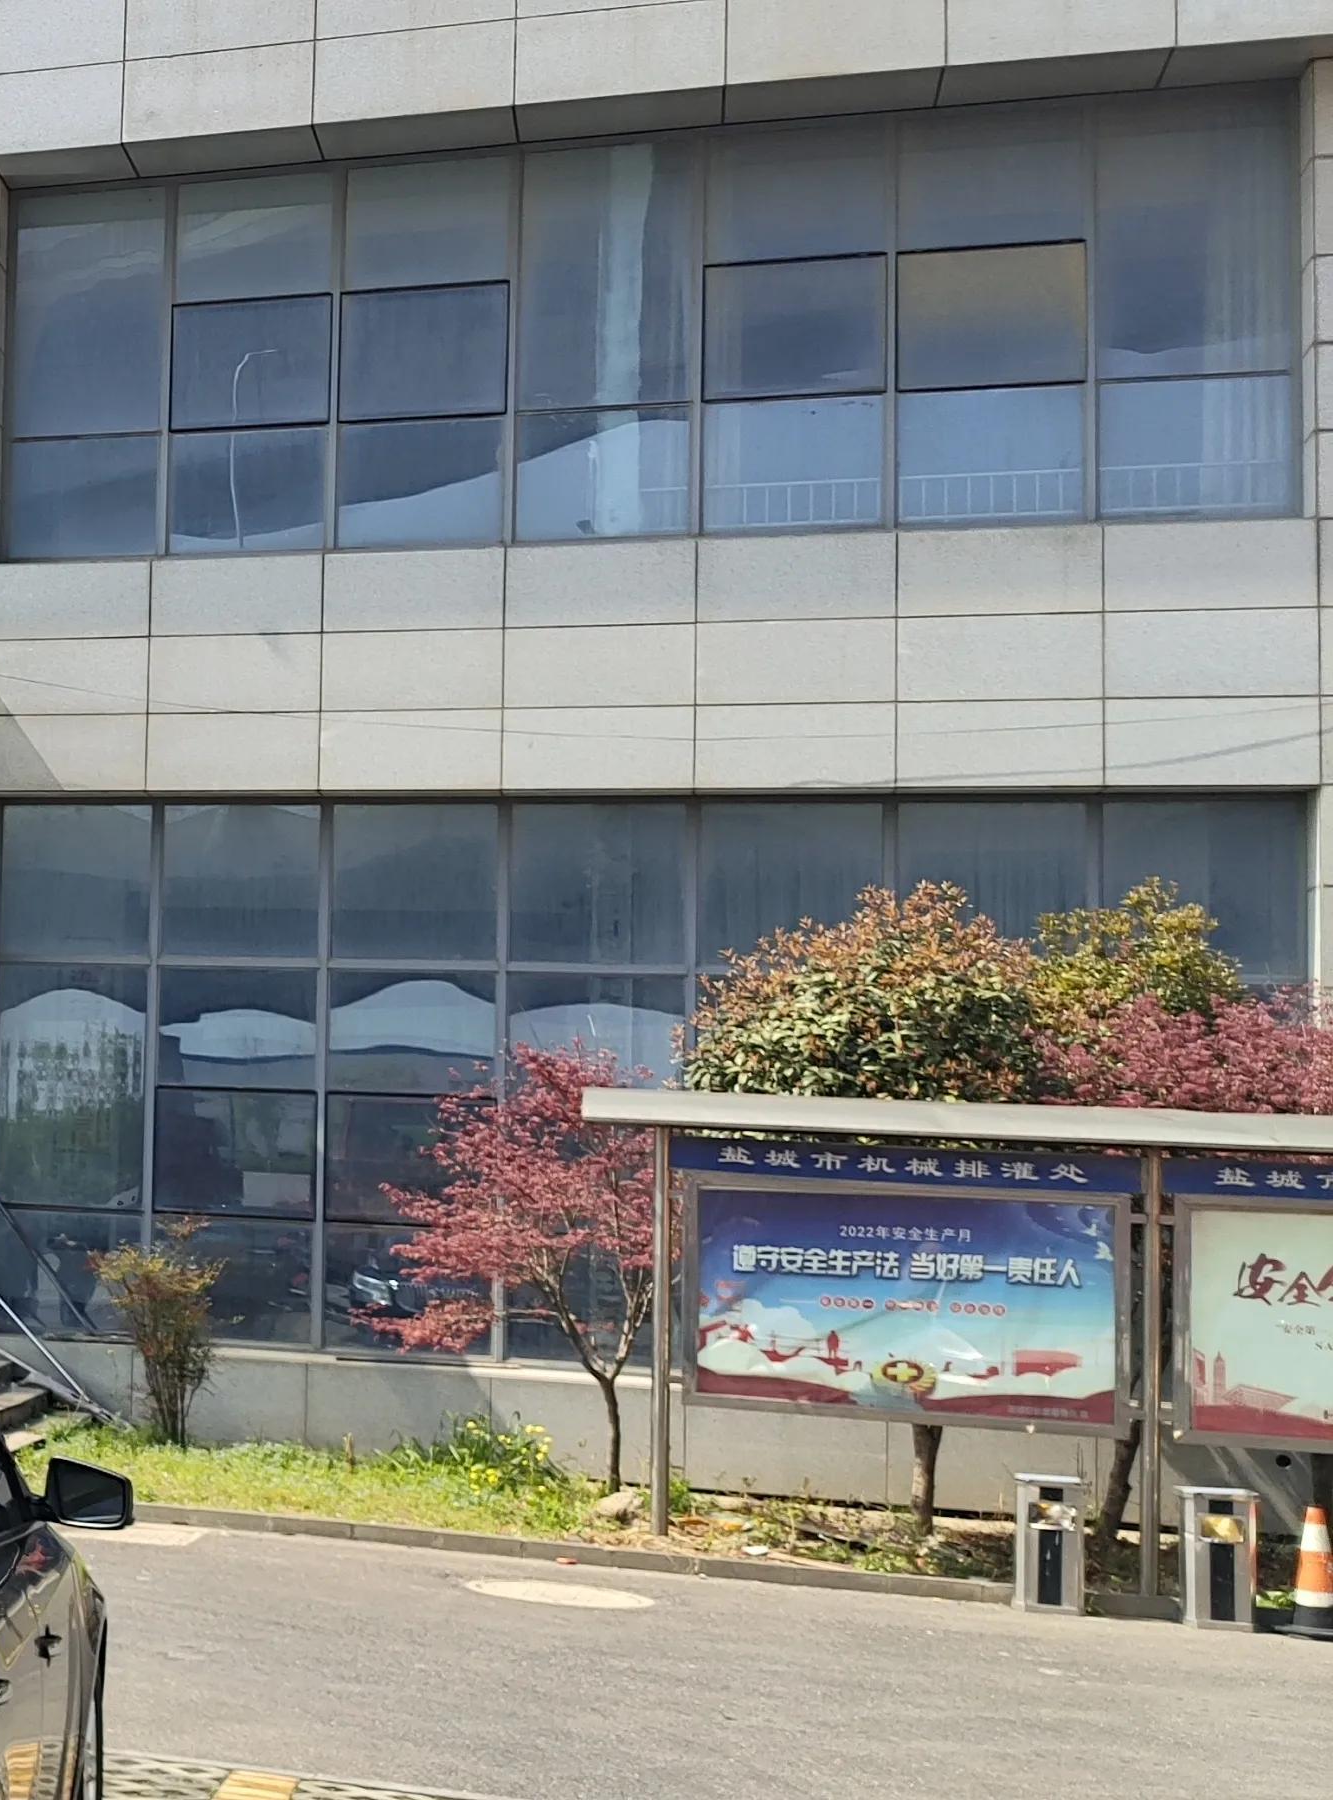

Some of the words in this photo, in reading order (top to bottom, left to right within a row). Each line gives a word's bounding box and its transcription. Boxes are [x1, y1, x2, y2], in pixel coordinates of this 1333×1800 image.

[718, 1145, 1090, 1184] 盐城市机械排灌处
[839, 1223, 972, 1243] 2022年安全生产月
[732, 1243, 902, 1280] 遵守安全生产法
[908, 1250, 1083, 1289] 当好第一责任人
